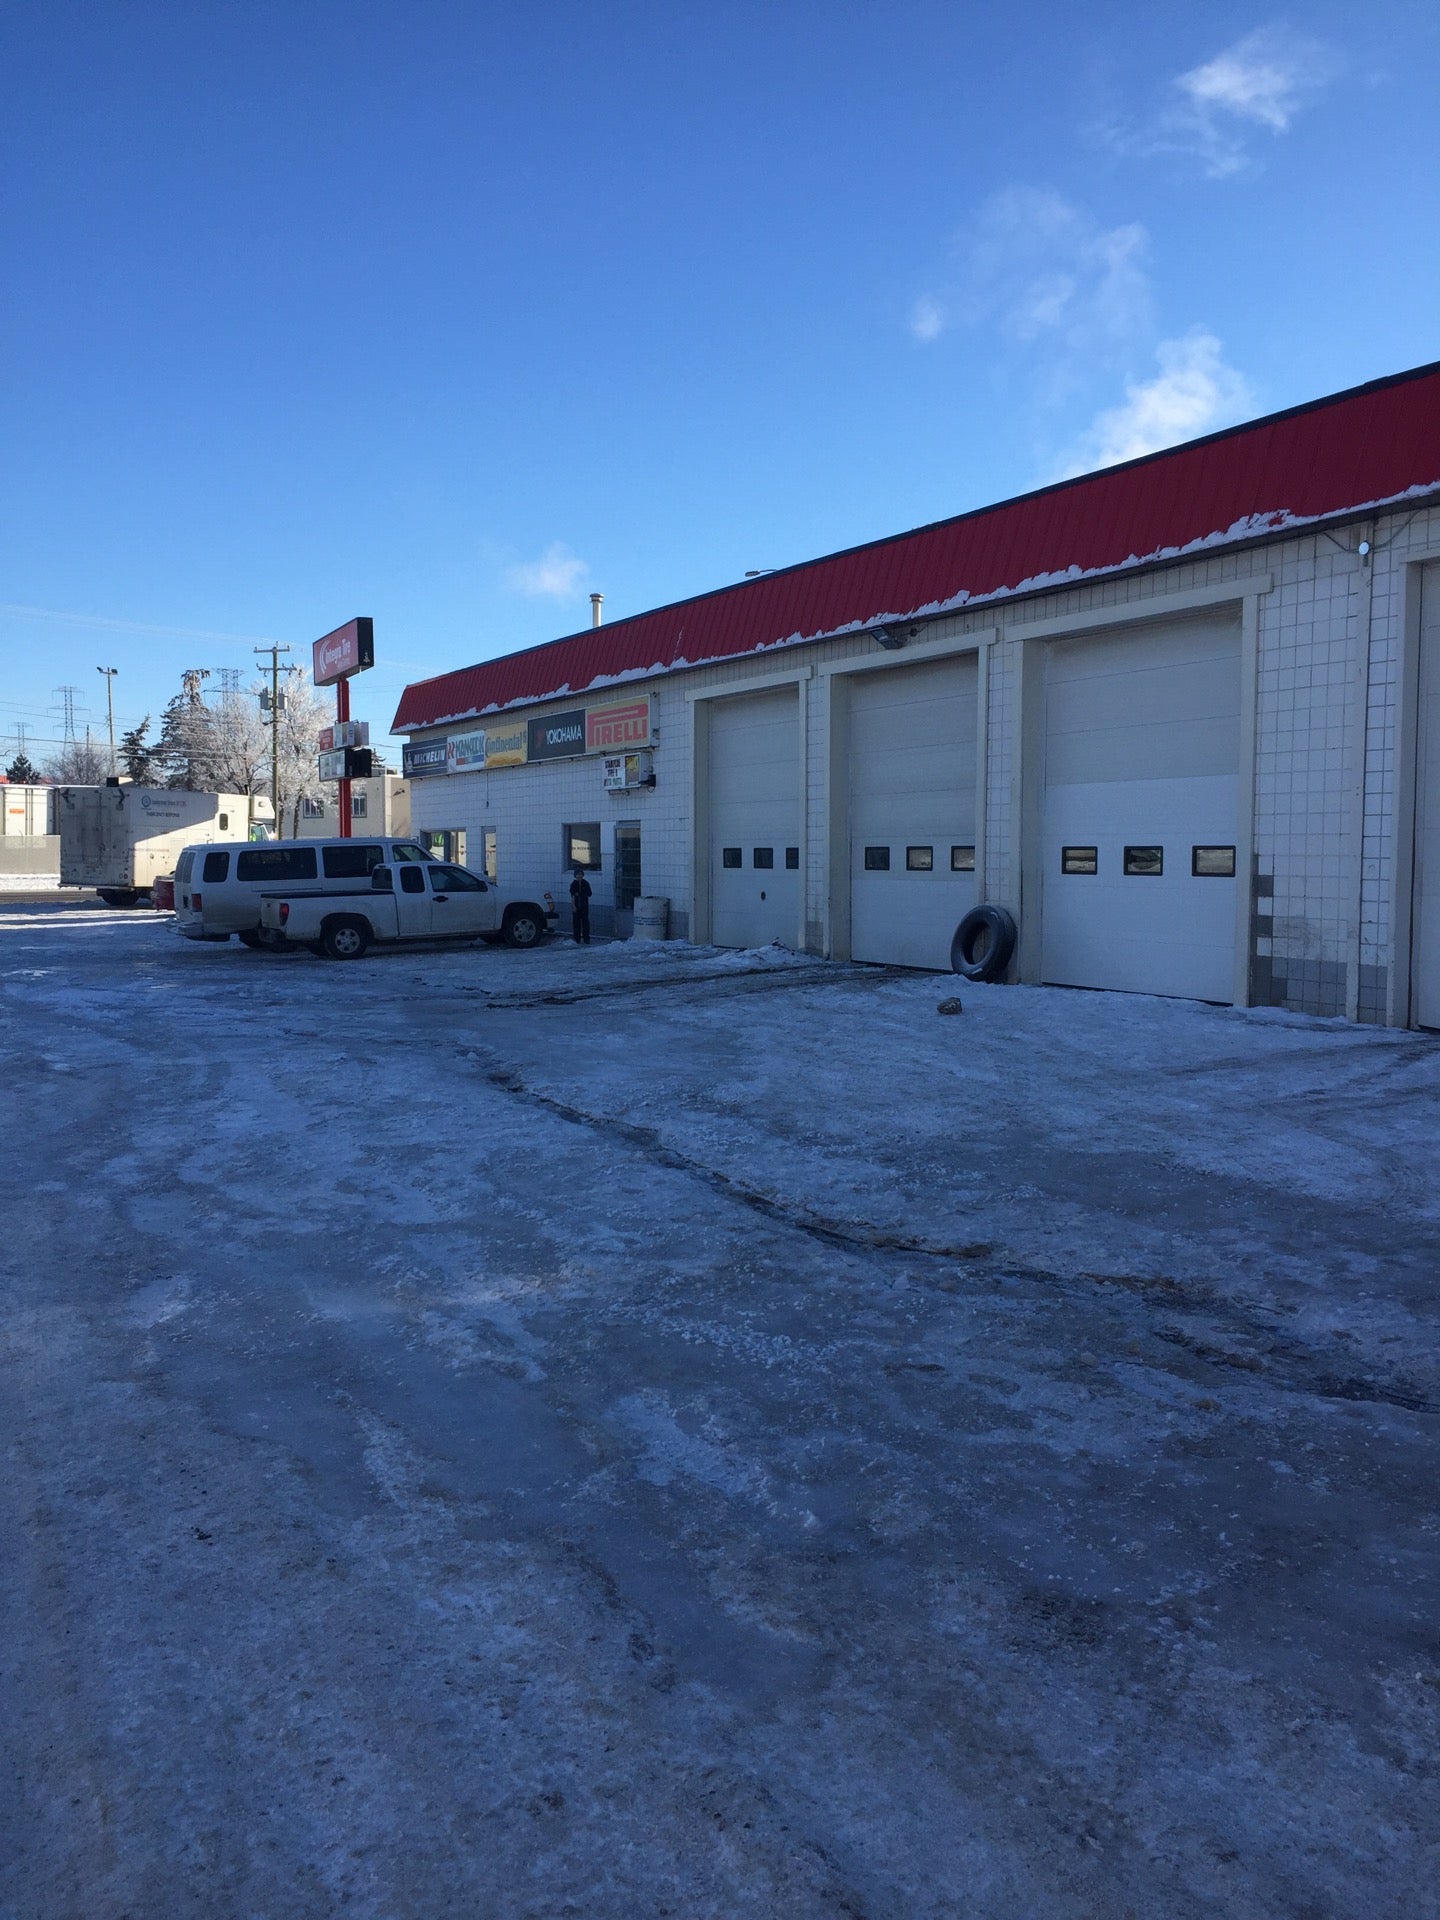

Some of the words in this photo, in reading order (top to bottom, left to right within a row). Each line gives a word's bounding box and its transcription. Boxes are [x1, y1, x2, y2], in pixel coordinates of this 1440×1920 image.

[546, 725, 583, 745] YOKOHAMA
[587, 703, 649, 747] PIRELLI
[413, 748, 446, 766] MICHELIN
